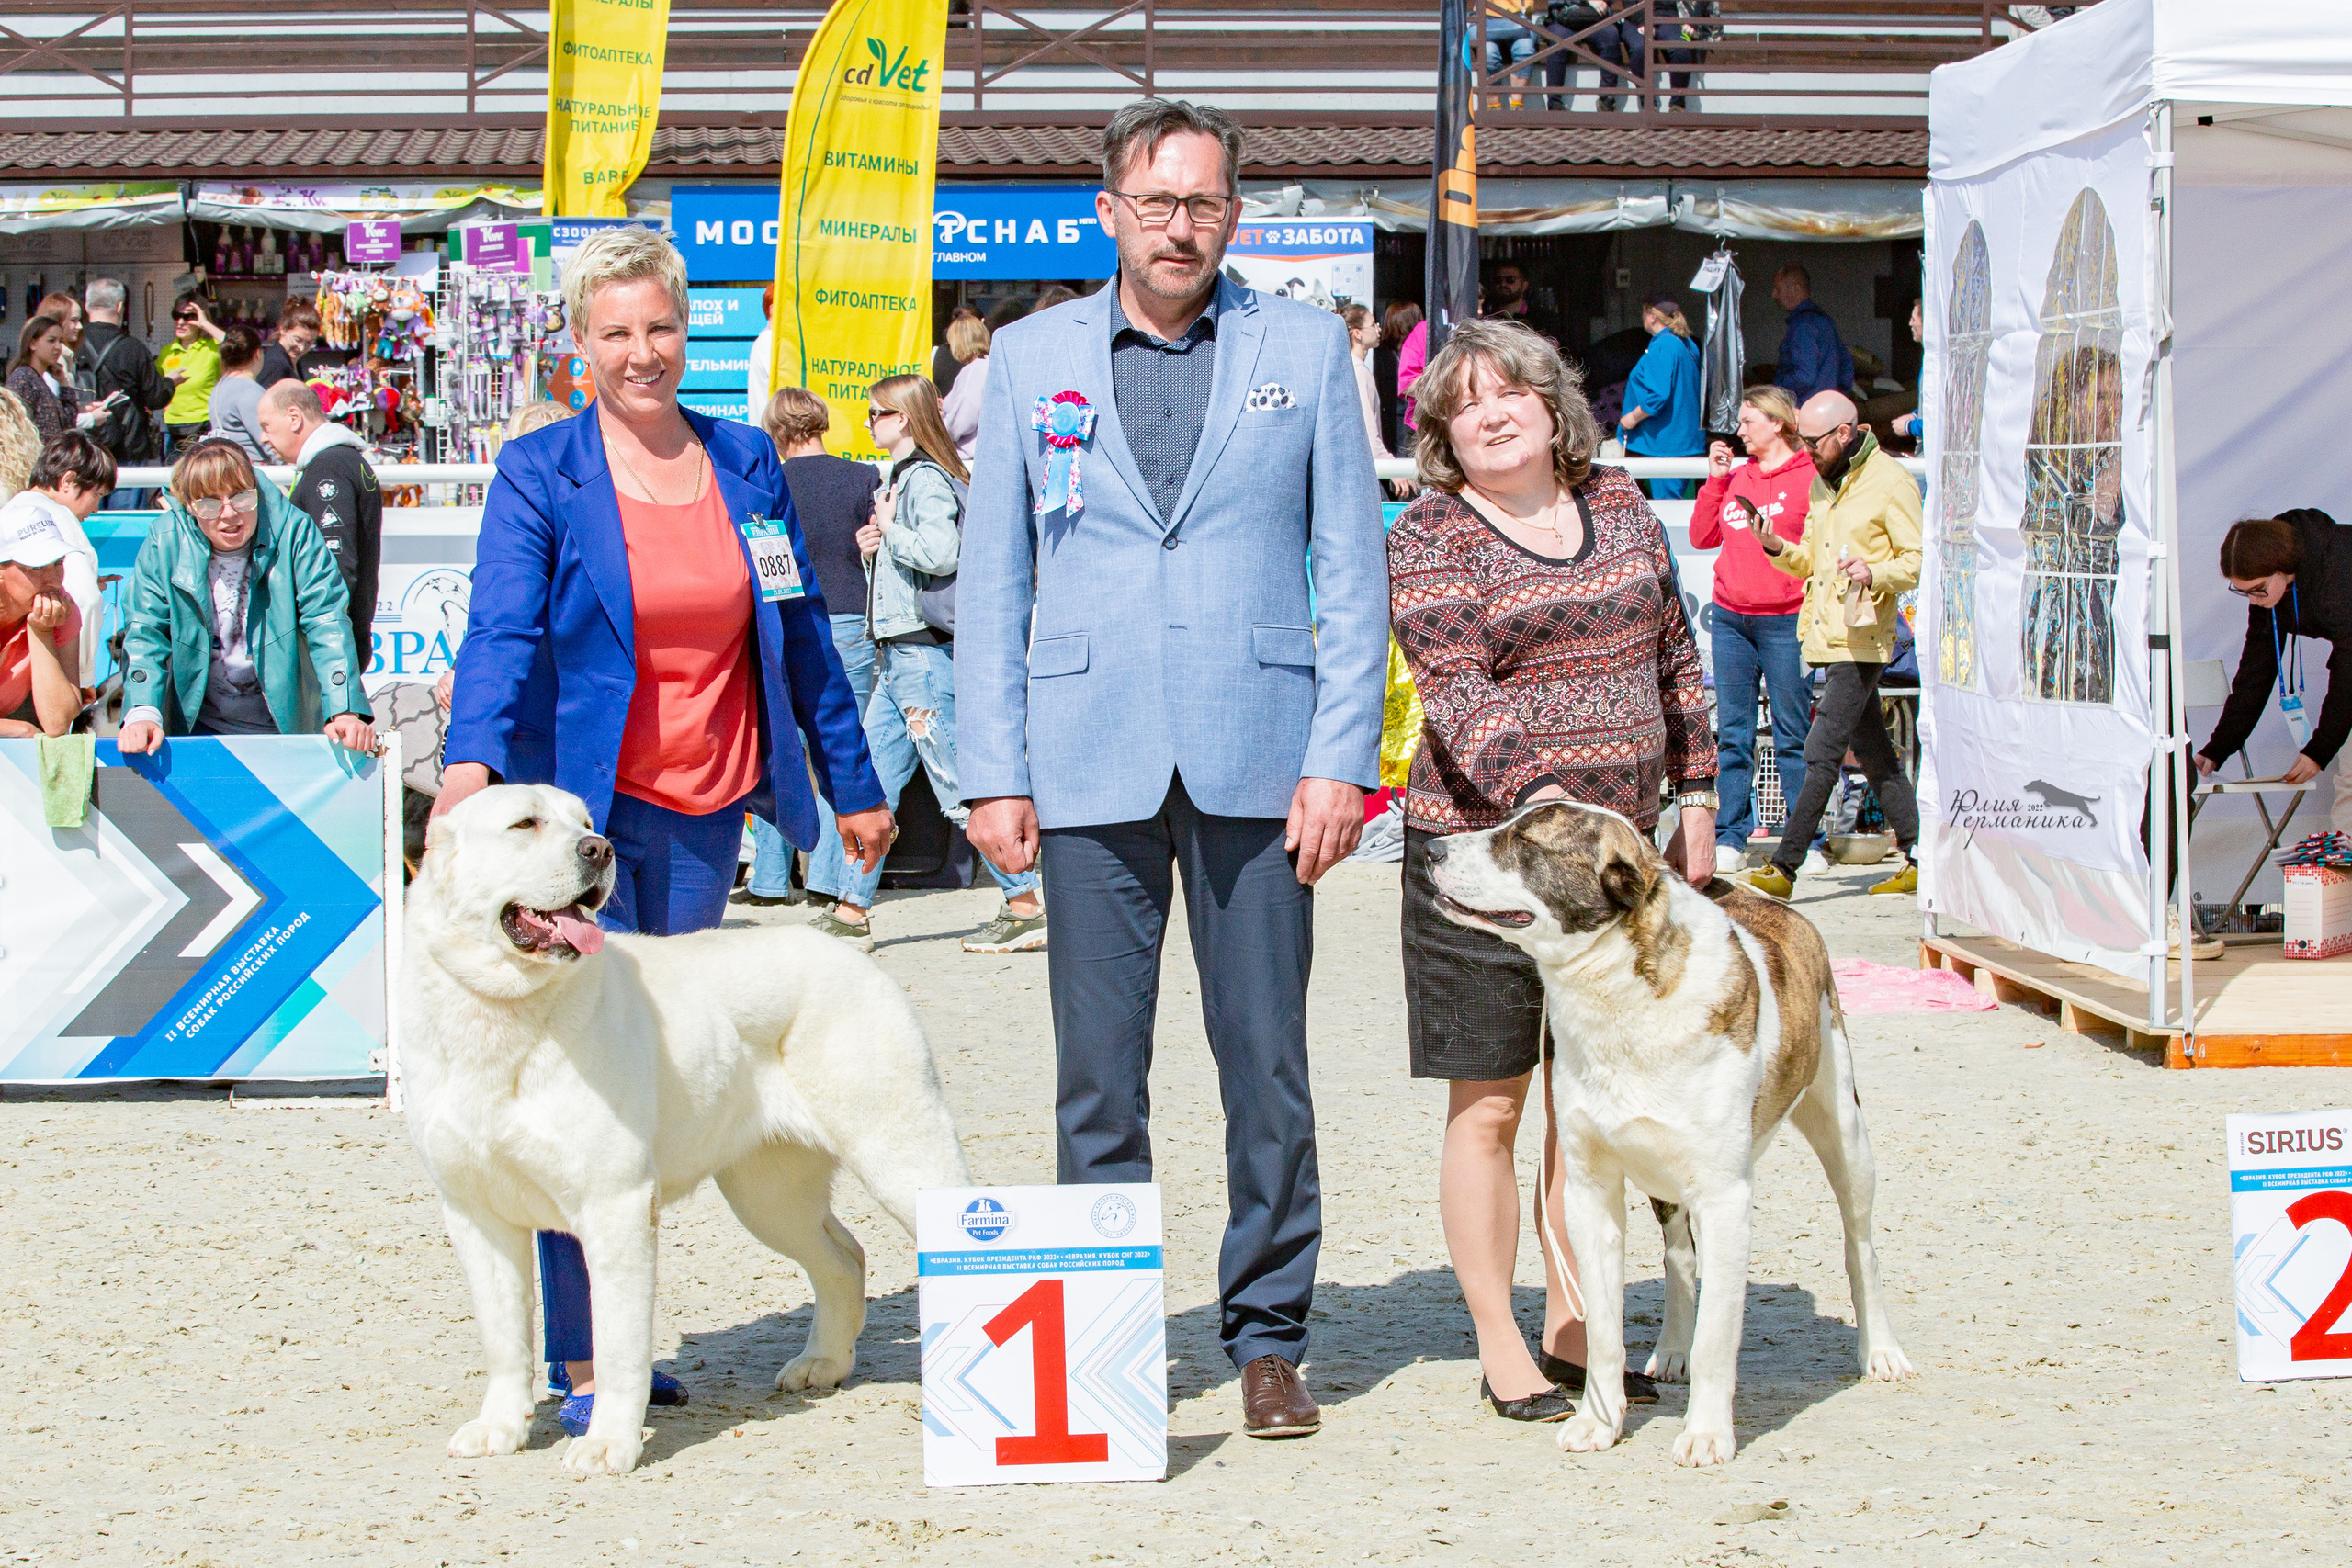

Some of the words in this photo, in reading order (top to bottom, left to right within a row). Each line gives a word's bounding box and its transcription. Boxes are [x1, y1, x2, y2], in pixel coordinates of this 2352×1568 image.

[562, 40, 654, 65] ФИТОАПТЕКА
[555, 97, 653, 118] НАТУРАЛЬНОЕ
[570, 119, 640, 134] ПИТАНИЕ
[823, 150, 919, 175] ВИТАМИНЫ
[820, 219, 917, 243] МИНЕРАЛЫ
[1281, 227, 1364, 246] ЗАБОТА
[932, 252, 987, 263] ГЛАВНОМ
[728, 299, 739, 311] И
[815, 288, 917, 312] ФИТОАПТЕКА
[759, 554, 791, 578] 0887
[365, 629, 467, 675] ВРА
[175, 974, 232, 1031] ВСЕМИРНАЯ
[231, 926, 279, 976] ВЫСТАВКА
[186, 1006, 218, 1039] СОБАК
[216, 944, 277, 1007] РОССИЙСКИХ
[276, 911, 311, 946] ПОРОД
[2247, 1127, 2343, 1155] SIRIUS
[961, 1213, 1010, 1226] Farmina
[963, 1263, 1001, 1271] ВСЕМИРНАЯ
[1059, 1259, 1102, 1268] РОССИЙСКИХ
[1065, 1251, 1098, 1260] «ЕВРАЗИЯ.
[2285, 1190, 2352, 1362] 2
[981, 1279, 1109, 1466] 1
